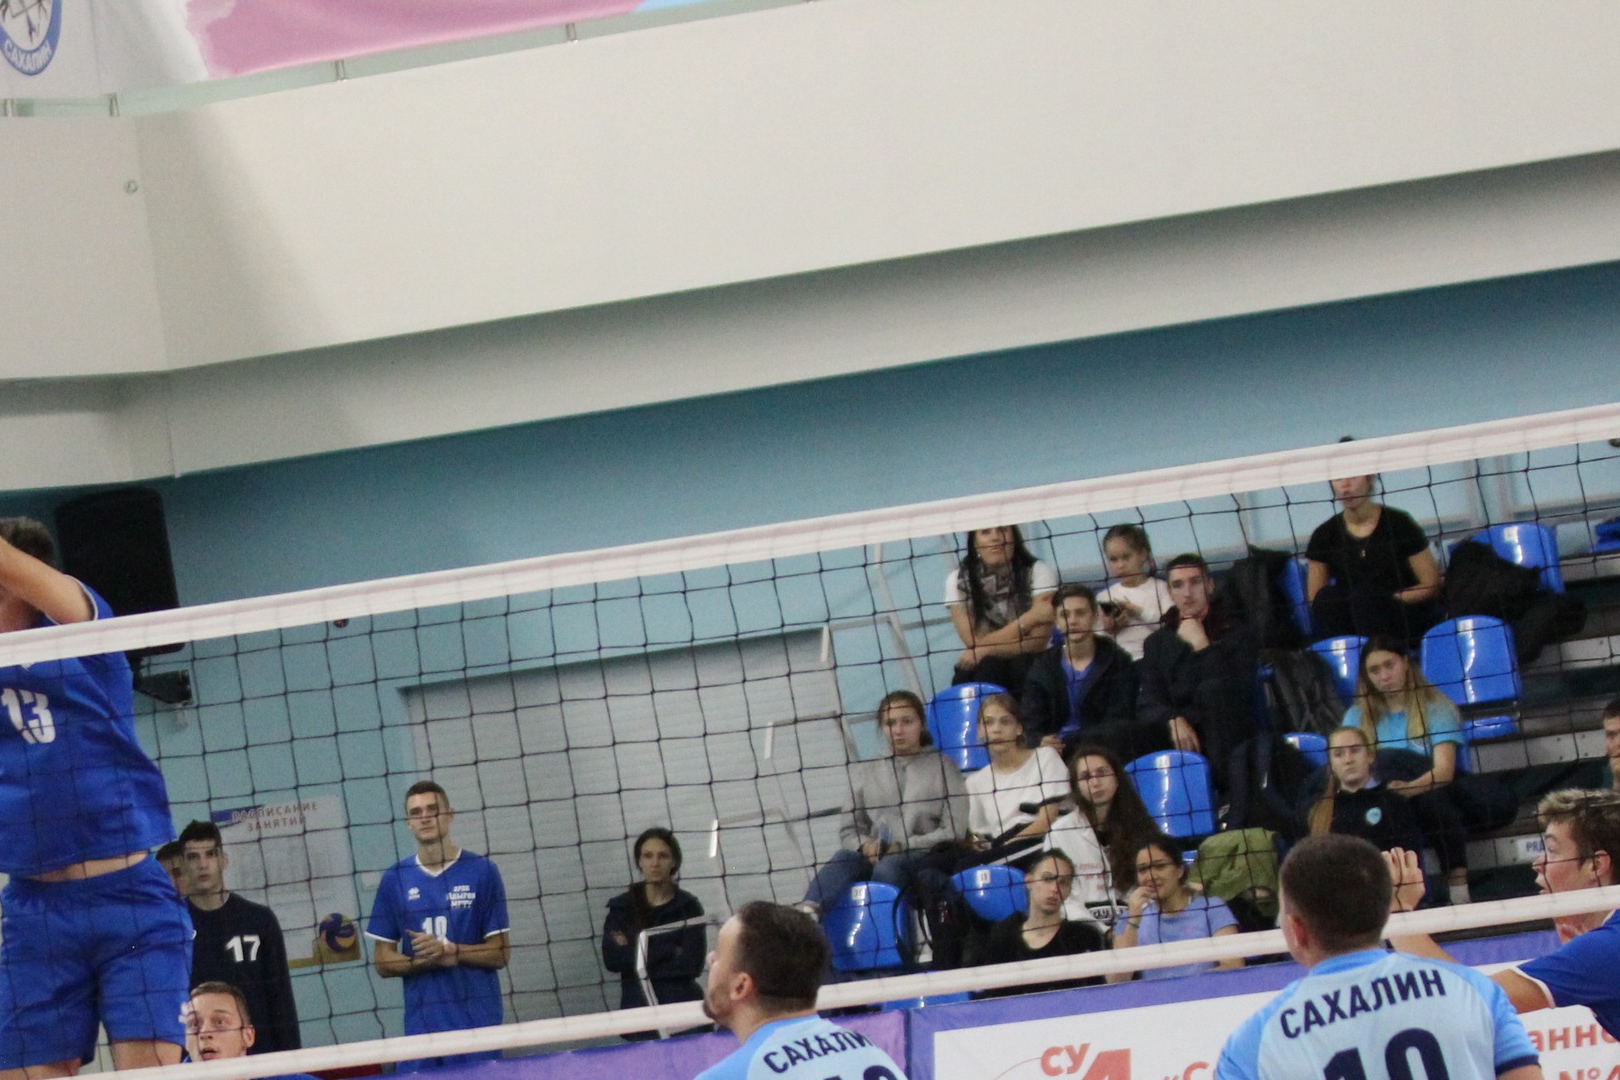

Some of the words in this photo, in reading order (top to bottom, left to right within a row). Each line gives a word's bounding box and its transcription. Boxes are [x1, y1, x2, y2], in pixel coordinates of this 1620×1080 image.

[1, 688, 56, 745] 13
[232, 802, 318, 821] РАСПИСАНИЕ
[247, 815, 306, 832] ЗАНЯТИЙ
[225, 934, 261, 962] 17
[1280, 968, 1447, 1040] САХАЛИН
